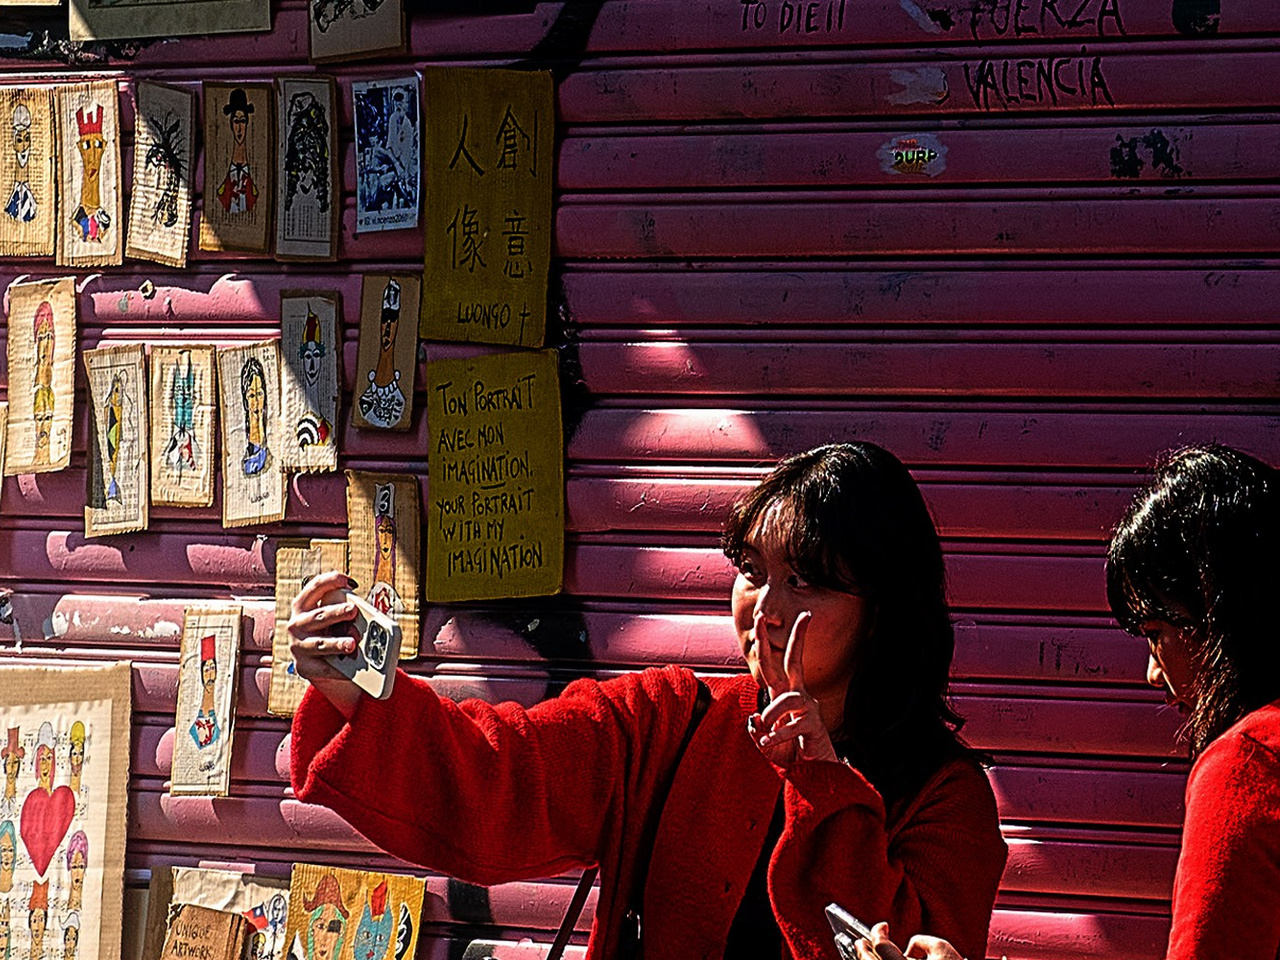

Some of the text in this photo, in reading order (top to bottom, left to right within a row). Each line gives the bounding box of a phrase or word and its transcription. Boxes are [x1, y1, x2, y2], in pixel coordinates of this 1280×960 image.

[740, 0, 767, 31] TO
[963, 46, 1116, 111] VALENCIA
[457, 302, 511, 330] LUONGO
[435, 374, 536, 417] TON PORTRAIT
[437, 421, 505, 454] AVEC MON
[436, 487, 535, 530] YOUR PORTRAIT
[442, 518, 505, 543] WITH MY
[447, 535, 543, 578] IMAGINATION
